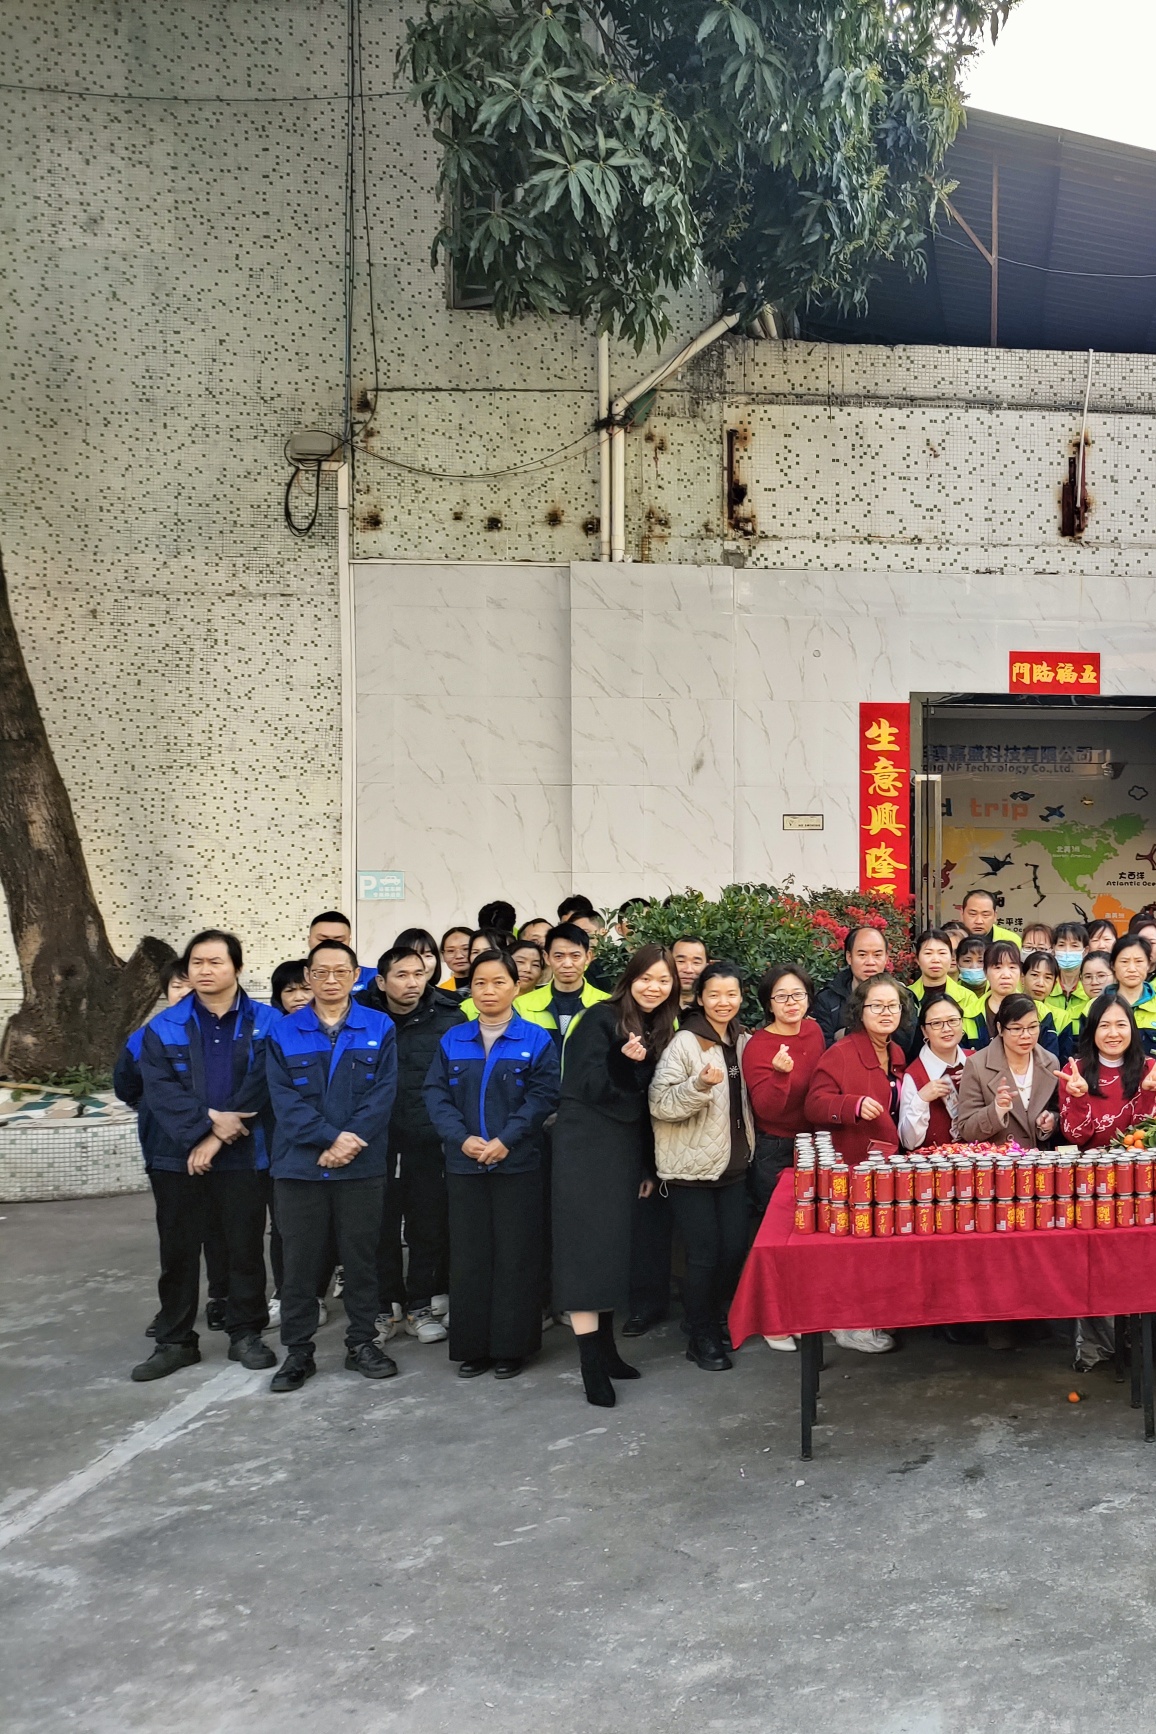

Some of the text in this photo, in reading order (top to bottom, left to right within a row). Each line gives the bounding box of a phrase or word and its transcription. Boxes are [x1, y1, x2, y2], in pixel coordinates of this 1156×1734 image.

[970, 798, 1028, 821] trip
[1118, 872, 1145, 880] 大西洋
